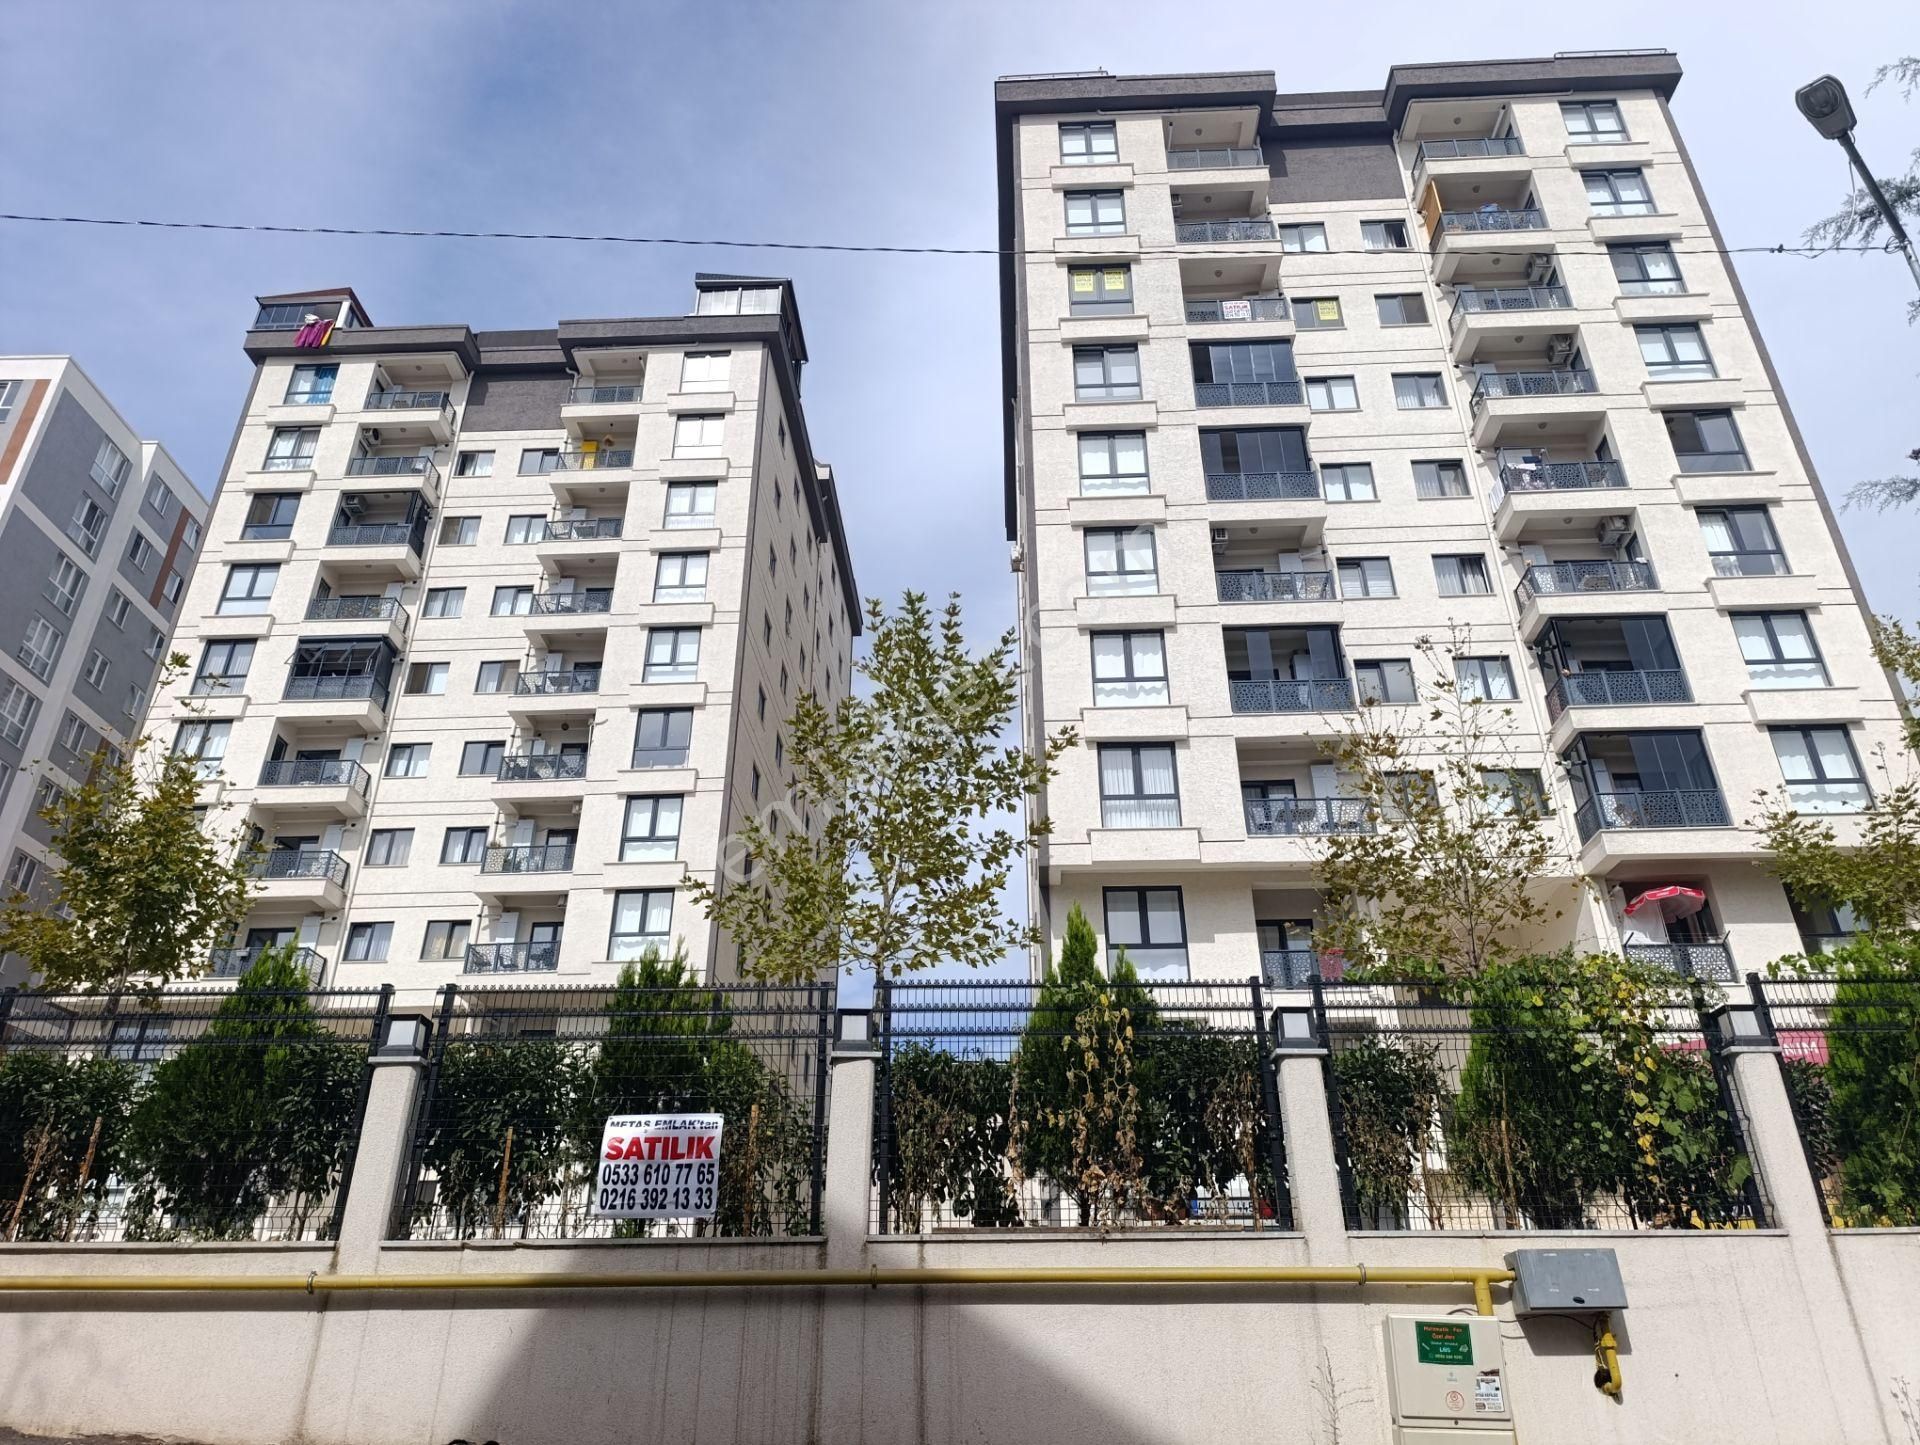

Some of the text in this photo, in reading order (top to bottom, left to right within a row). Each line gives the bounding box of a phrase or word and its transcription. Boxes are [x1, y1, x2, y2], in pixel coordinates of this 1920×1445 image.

[605, 1136, 715, 1160] SATILIK
[602, 1163, 715, 1186] 0533 610 77 65
[600, 1187, 713, 1210] 0216 392 13 33
